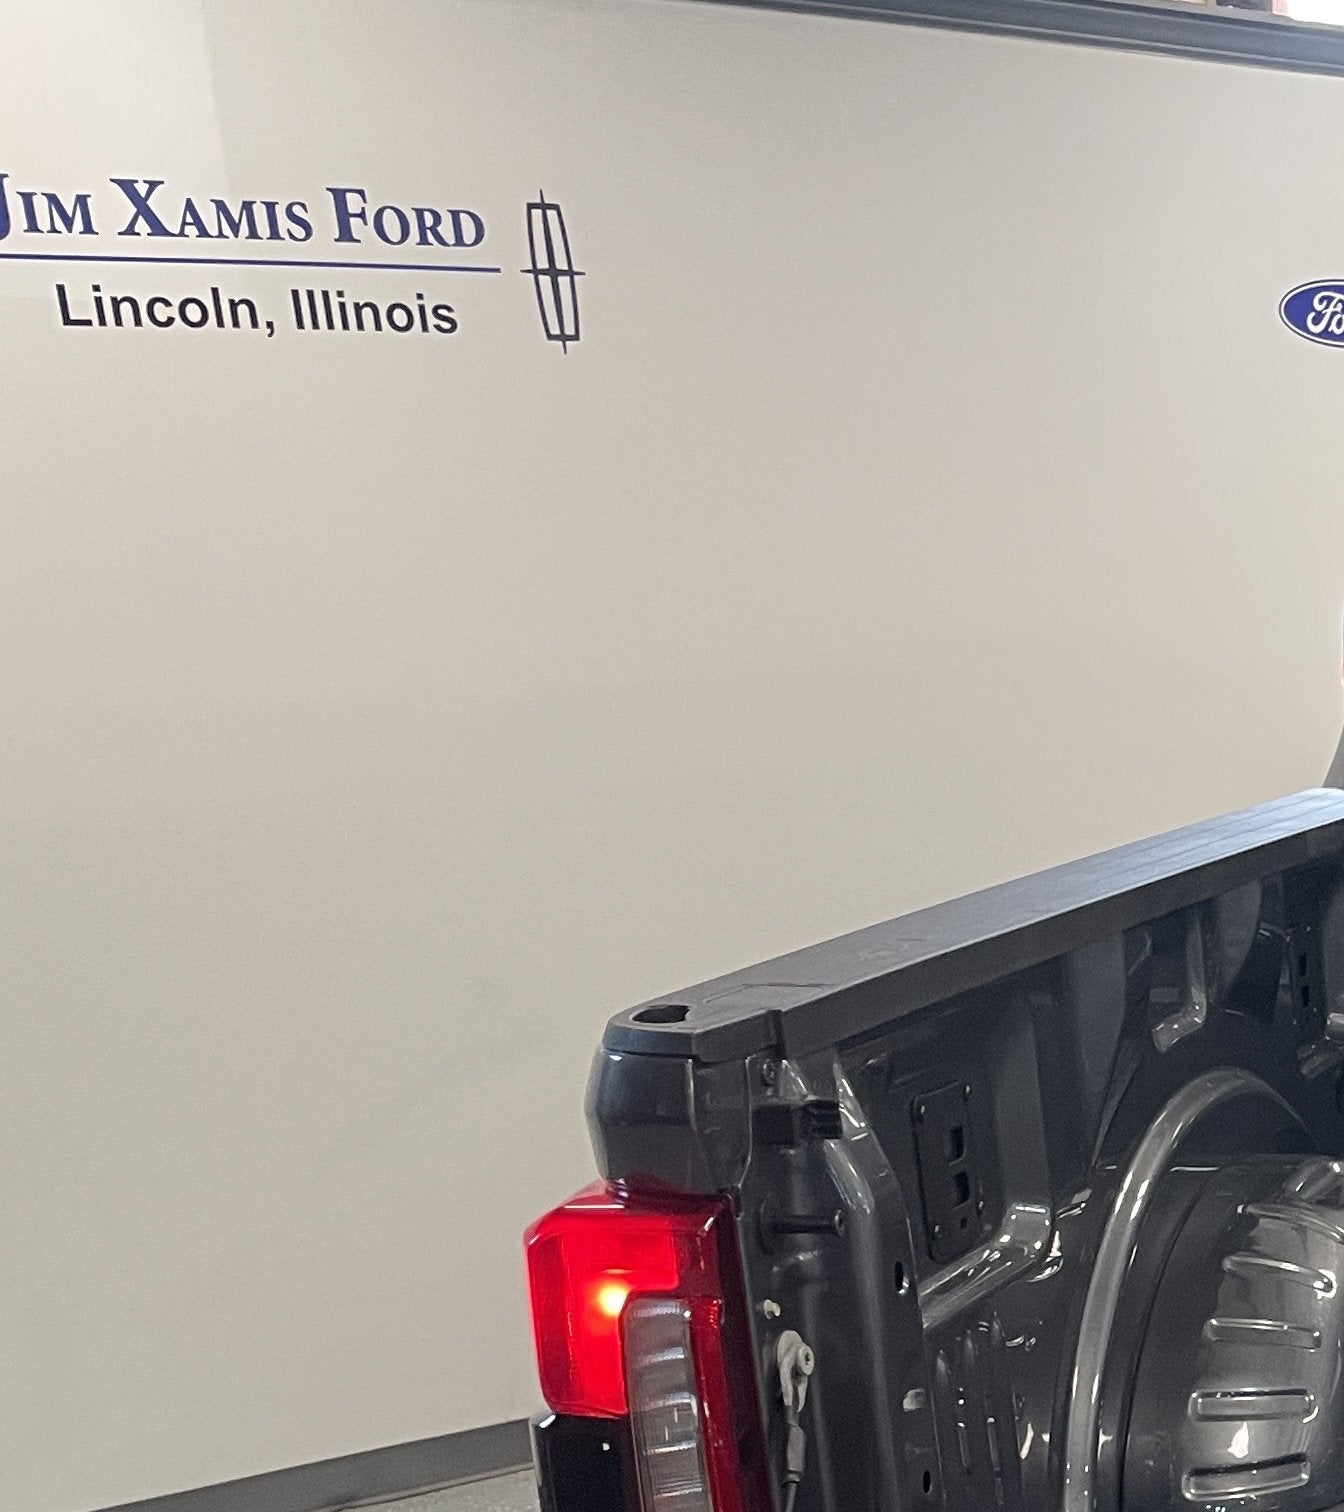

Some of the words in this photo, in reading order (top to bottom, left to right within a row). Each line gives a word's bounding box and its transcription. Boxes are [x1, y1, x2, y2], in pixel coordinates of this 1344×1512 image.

[109, 178, 313, 242] XAMIS
[326, 187, 486, 248] FORD
[55, 284, 275, 338] Lincoln,
[290, 288, 458, 335] Illinois
